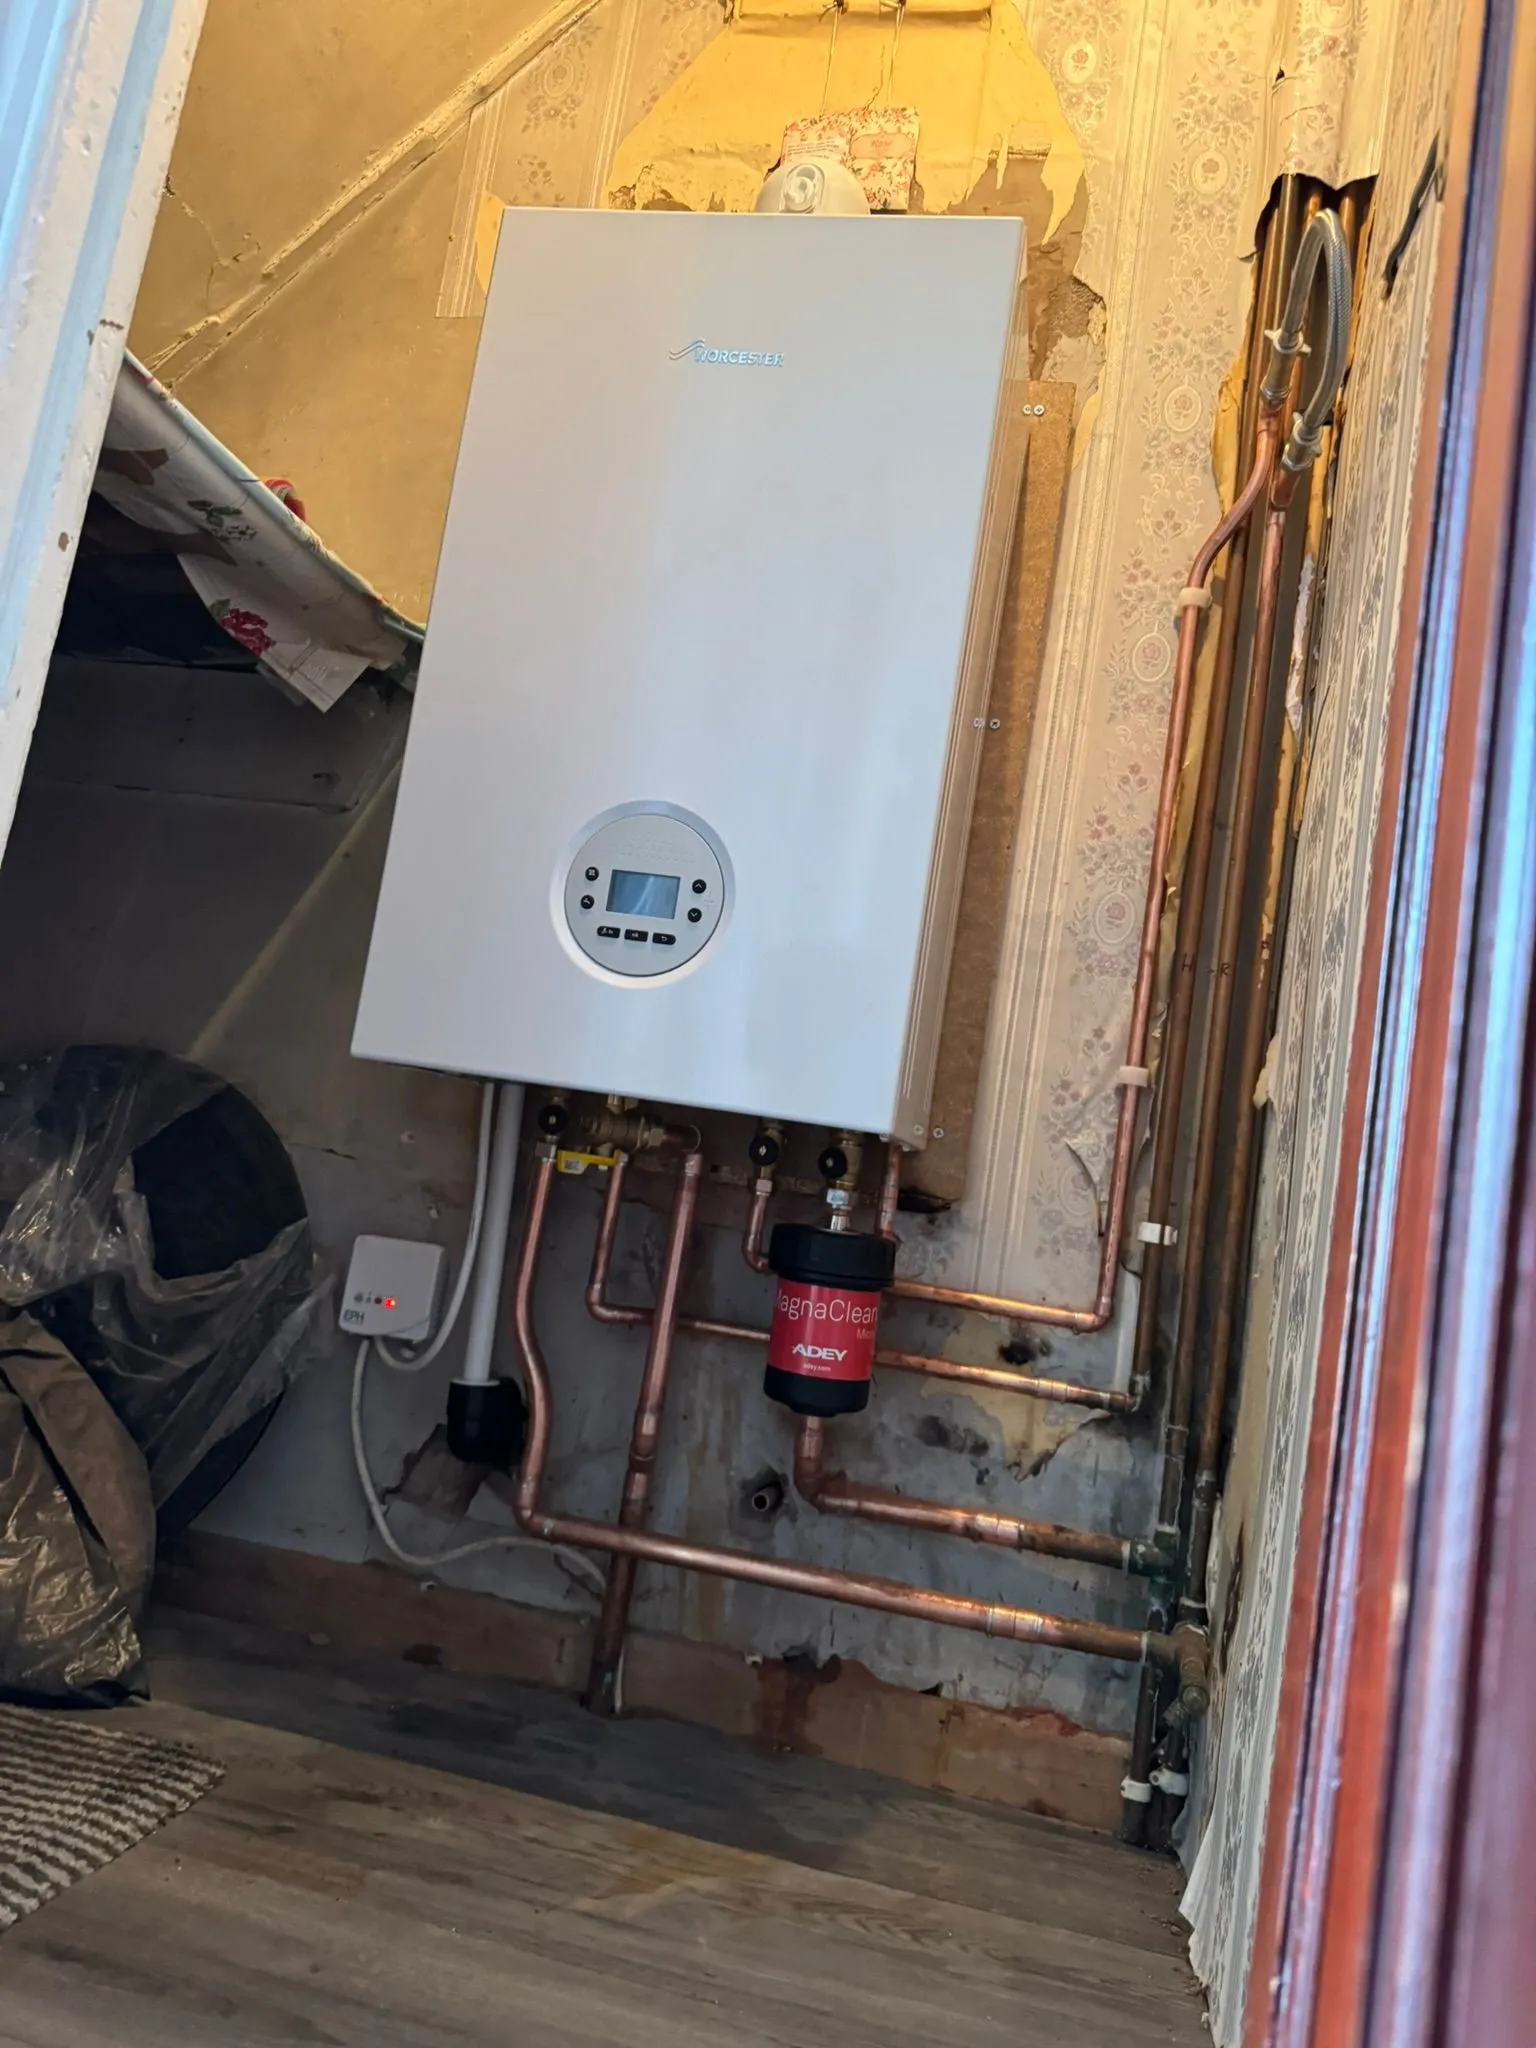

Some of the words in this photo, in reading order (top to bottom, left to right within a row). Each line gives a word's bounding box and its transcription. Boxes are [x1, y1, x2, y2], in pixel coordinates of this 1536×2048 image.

[694, 349, 784, 367] WORCESTER
[343, 1309, 365, 1323] EPH
[791, 1343, 848, 1362] ADEY
